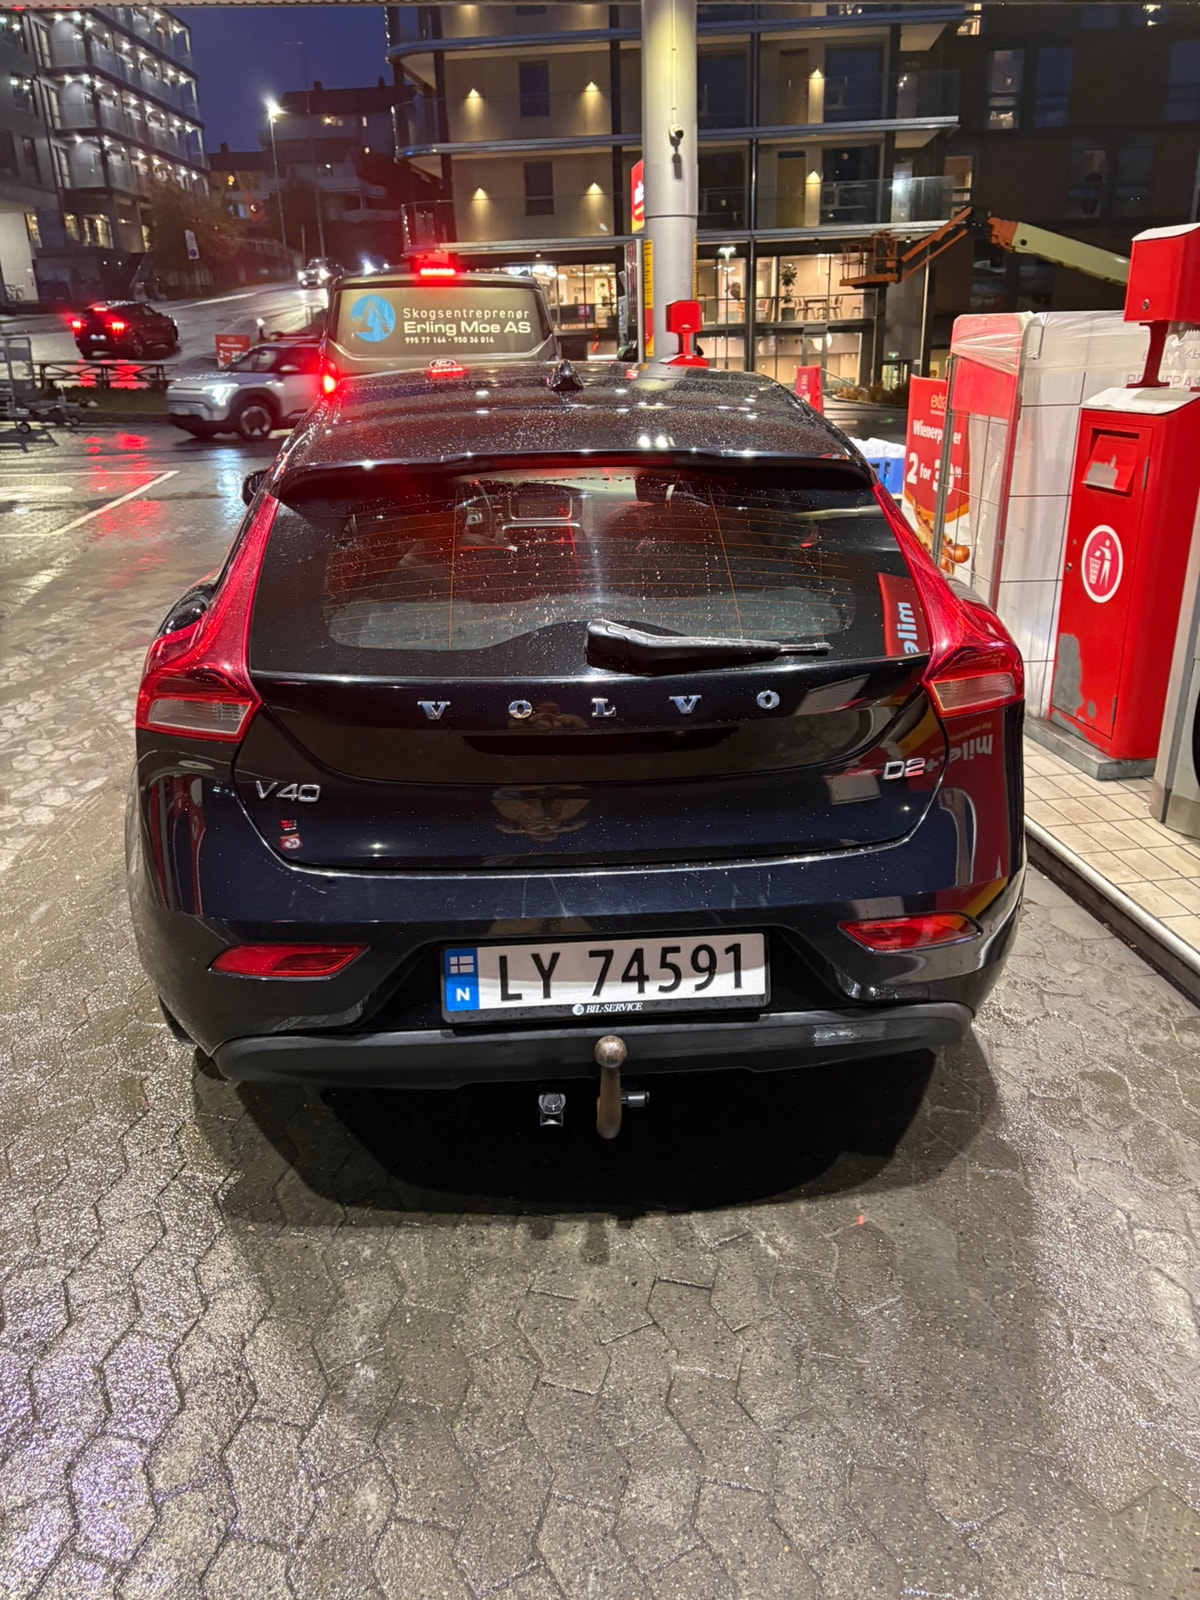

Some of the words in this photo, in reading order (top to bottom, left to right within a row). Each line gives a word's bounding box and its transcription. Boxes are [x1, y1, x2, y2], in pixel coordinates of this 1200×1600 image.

[403, 307, 529, 320] Skogsentreprenør
[404, 321, 457, 336] Erling
[461, 321, 501, 334] Moe
[504, 321, 532, 334] AS
[405, 336, 419, 344] 995
[421, 336, 431, 344] 77
[453, 336, 468, 344] 950
[469, 336, 479, 344] 36
[480, 336, 495, 344] 014
[906, 452, 919, 485] 2
[919, 463, 932, 481] for
[883, 757, 926, 780] D2
[255, 780, 321, 803] V40
[498, 951, 561, 1003] LY
[588, 943, 742, 997] 74591
[455, 987, 470, 1002] N
